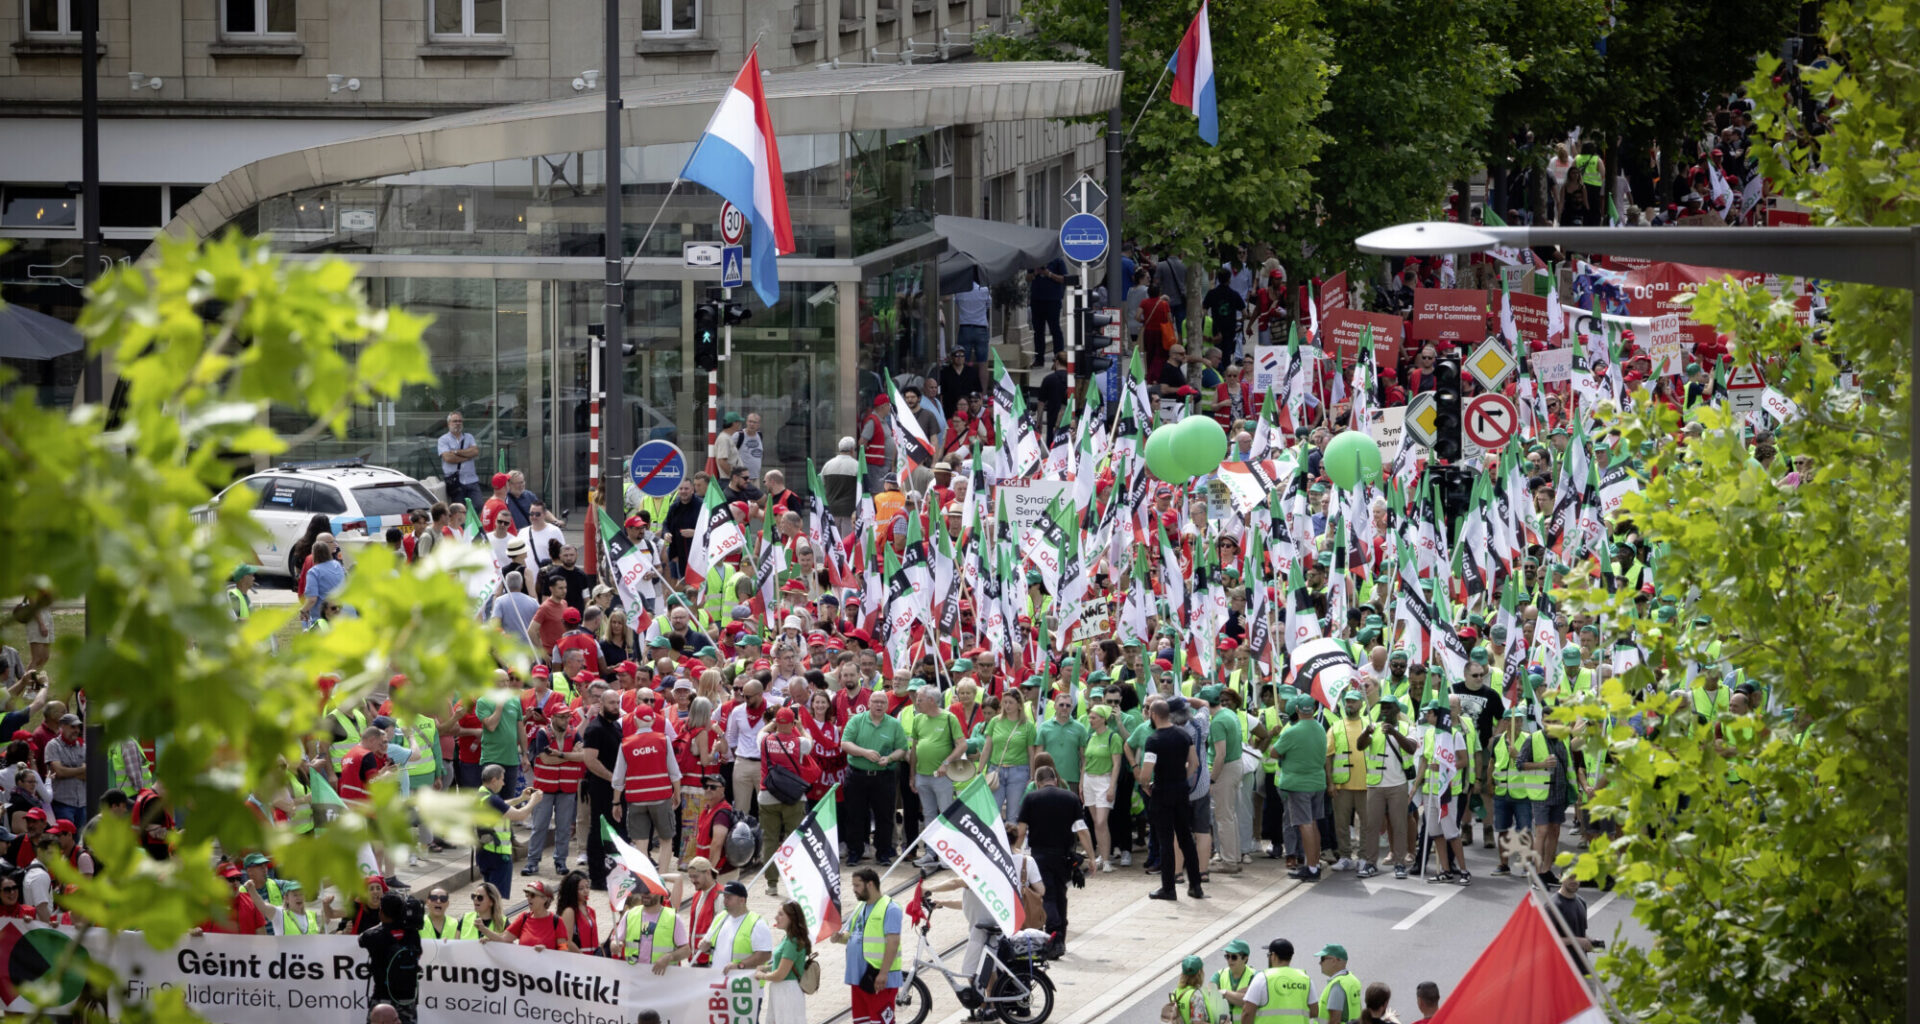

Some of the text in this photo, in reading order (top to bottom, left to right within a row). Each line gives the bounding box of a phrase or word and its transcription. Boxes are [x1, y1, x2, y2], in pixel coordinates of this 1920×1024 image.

[727, 211, 740, 231] 30
[1424, 303, 1477, 313] CCT sectorielle
[1510, 304, 1535, 314] ouche
[1418, 312, 1482, 321] pour le Commerce
[1522, 314, 1539, 325] jour
[1371, 324, 1387, 333] pour
[1650, 318, 1677, 333] METRO
[1332, 328, 1346, 336] des
[1383, 335, 1393, 343] de
[1333, 337, 1357, 346] travail
[1768, 397, 1789, 415] OGB·
[1383, 426, 1402, 436] Synd
[1377, 439, 1400, 448] Servi
[1015, 494, 1065, 506] Syndict
[1015, 507, 1043, 516] Servi
[1040, 551, 1058, 572] OGB
[959, 813, 1021, 889] frontsyndic
[791, 885, 817, 928] LCGB
[977, 881, 1011, 922] LCGB
[177, 948, 621, 1005] Géint dës Rerungspolitik!
[127, 979, 626, 1024] Fir lidaritéit, Demok a sozial Gerechte
[731, 976, 753, 1024] GB
